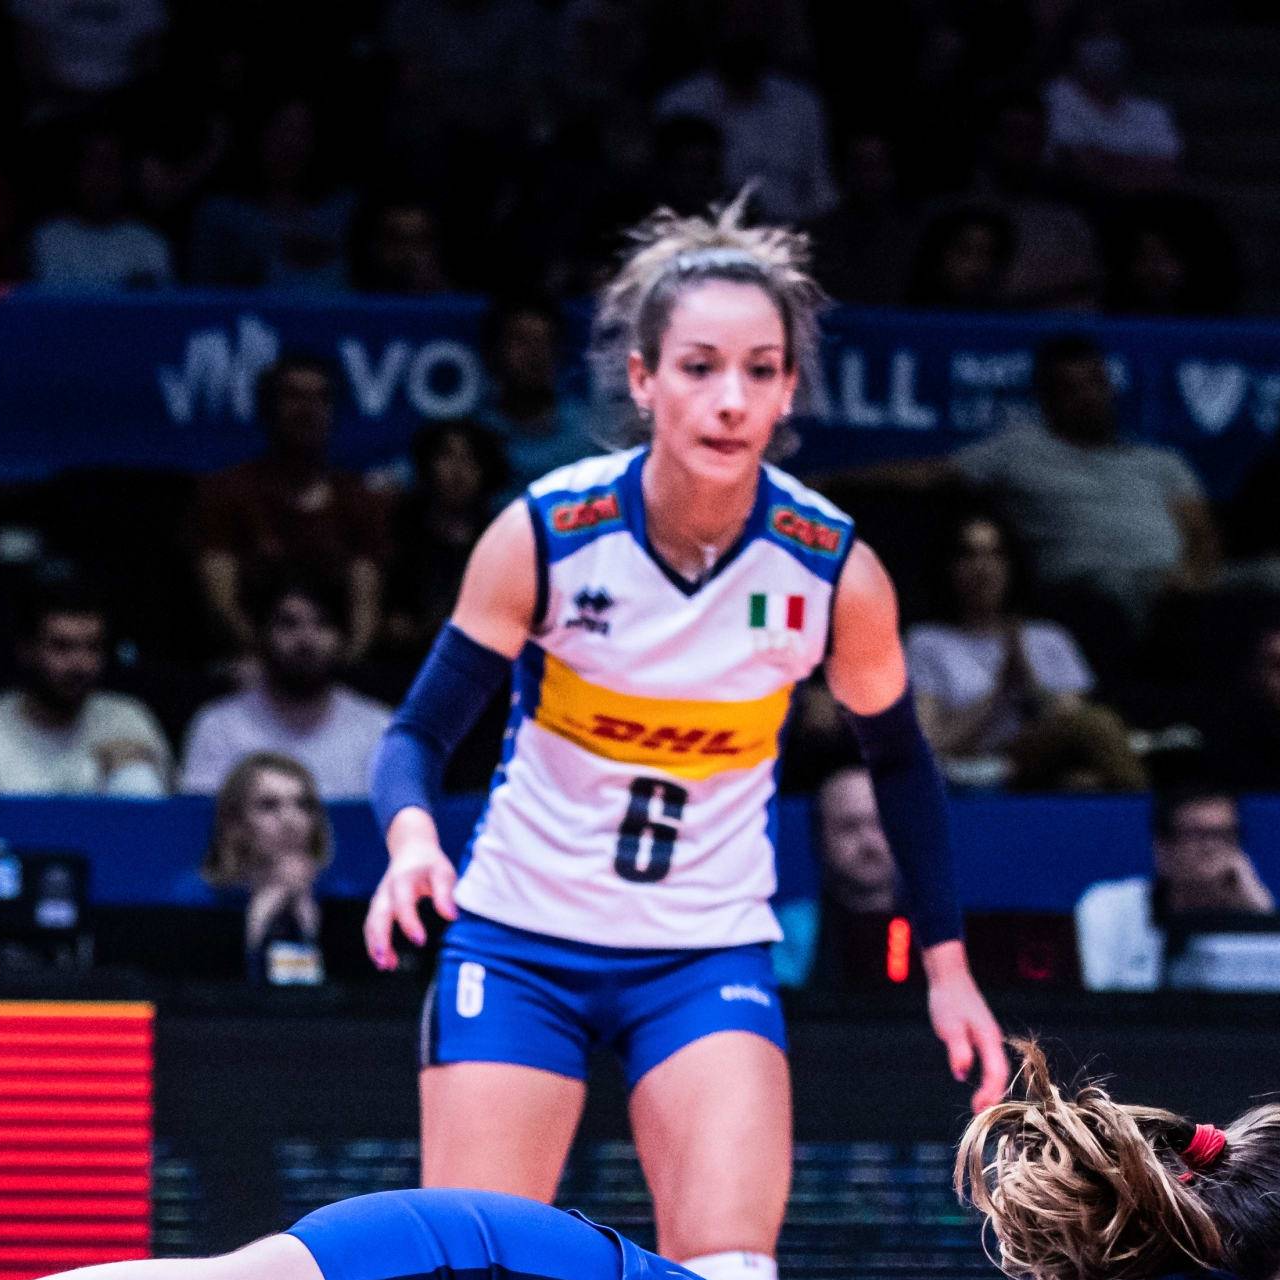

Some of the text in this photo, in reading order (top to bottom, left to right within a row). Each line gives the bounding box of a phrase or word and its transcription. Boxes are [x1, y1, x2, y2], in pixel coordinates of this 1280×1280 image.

[591, 713, 742, 756] DHL
[614, 776, 689, 884] 6
[456, 961, 487, 1018] 6
